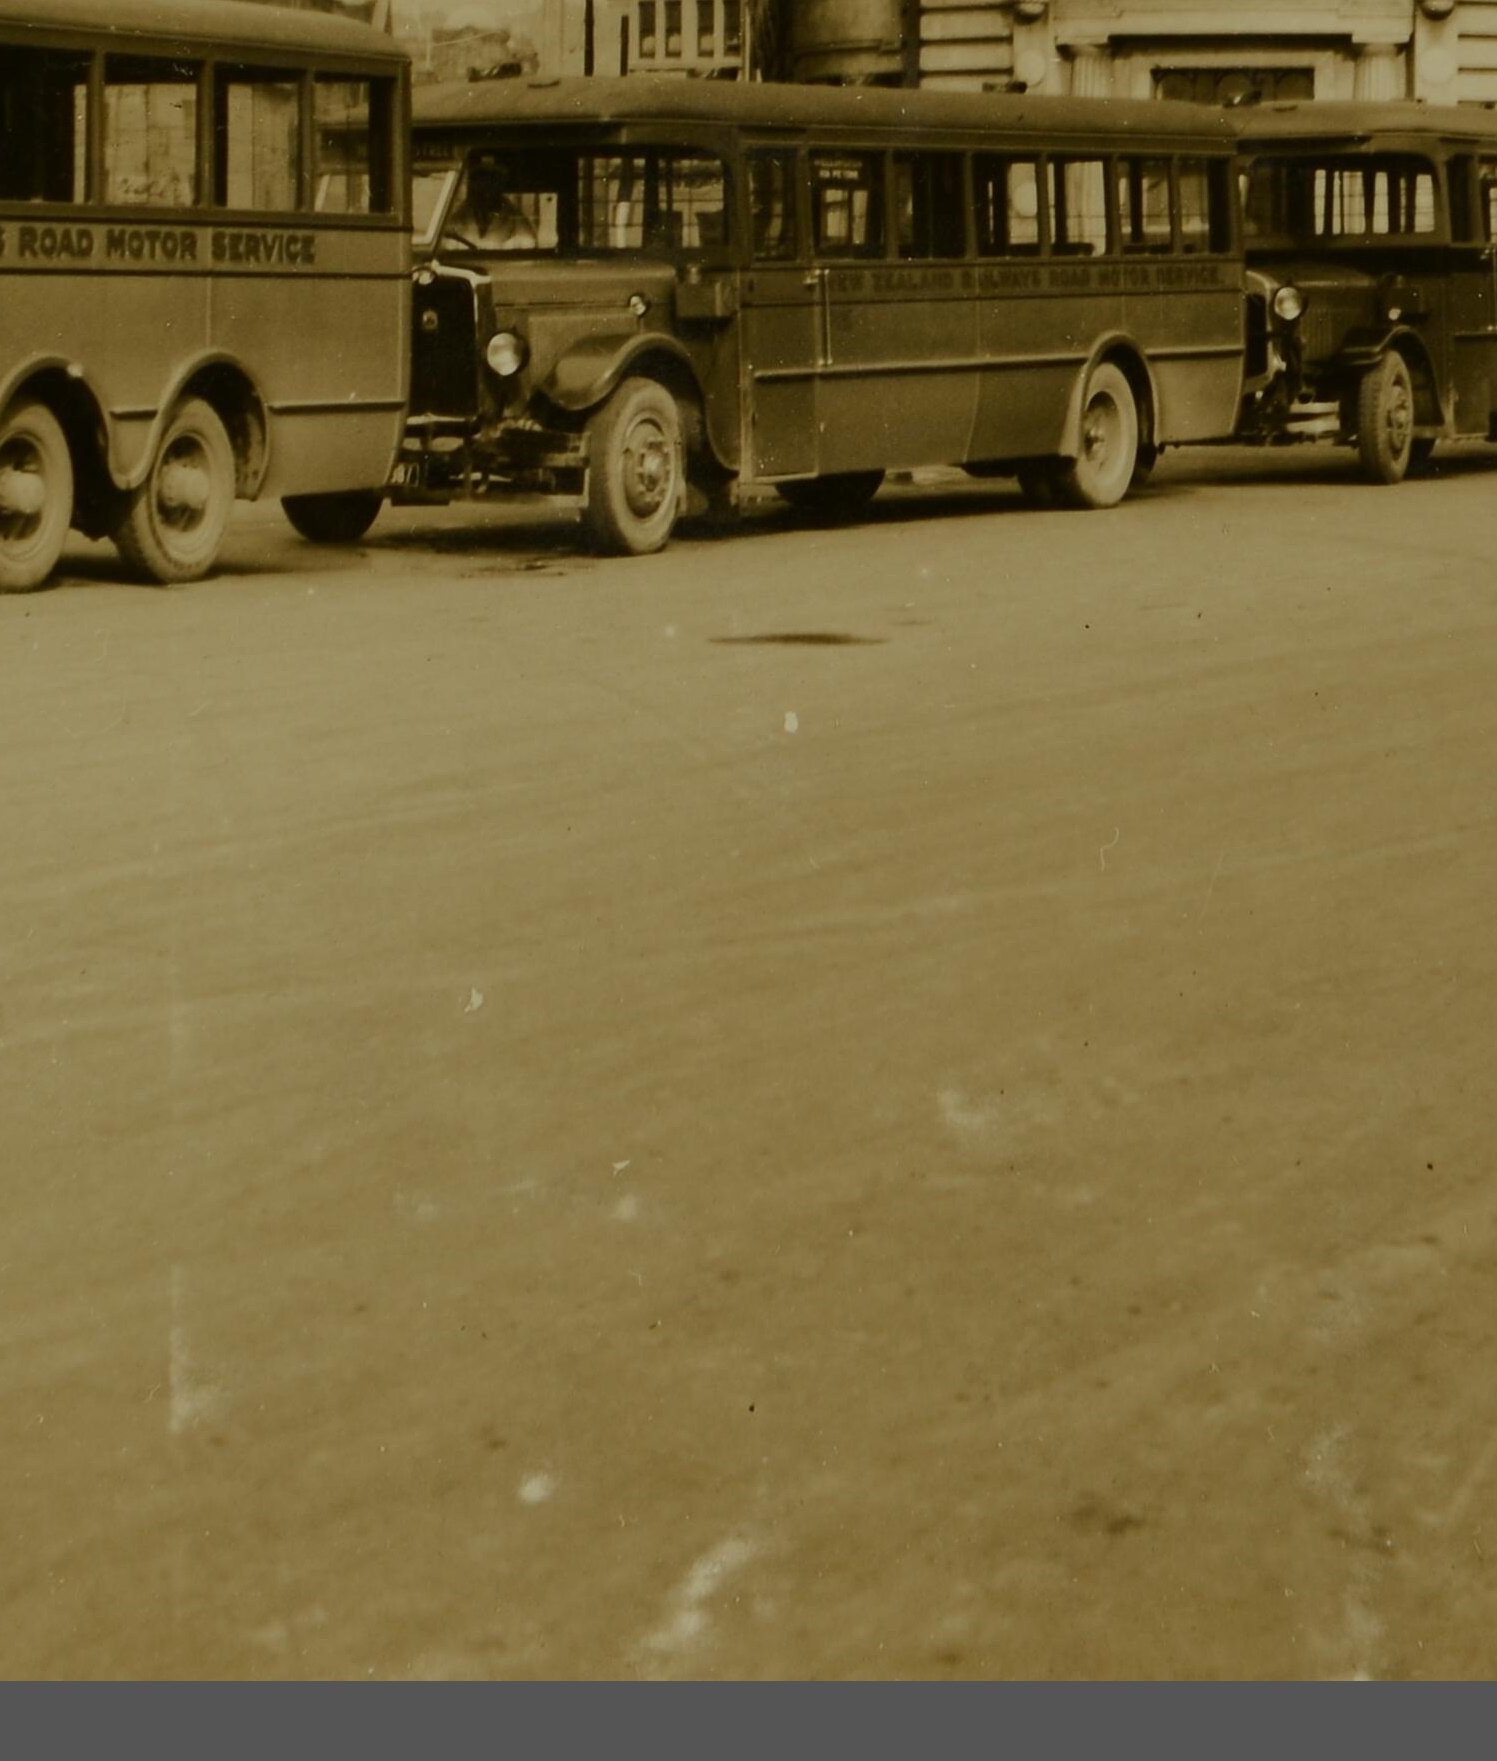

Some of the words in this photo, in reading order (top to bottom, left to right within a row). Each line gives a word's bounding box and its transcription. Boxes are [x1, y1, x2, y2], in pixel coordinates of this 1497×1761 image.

[19, 226, 95, 259] ROAD
[106, 228, 198, 261] MOTOR
[211, 231, 316, 264] SERVICE
